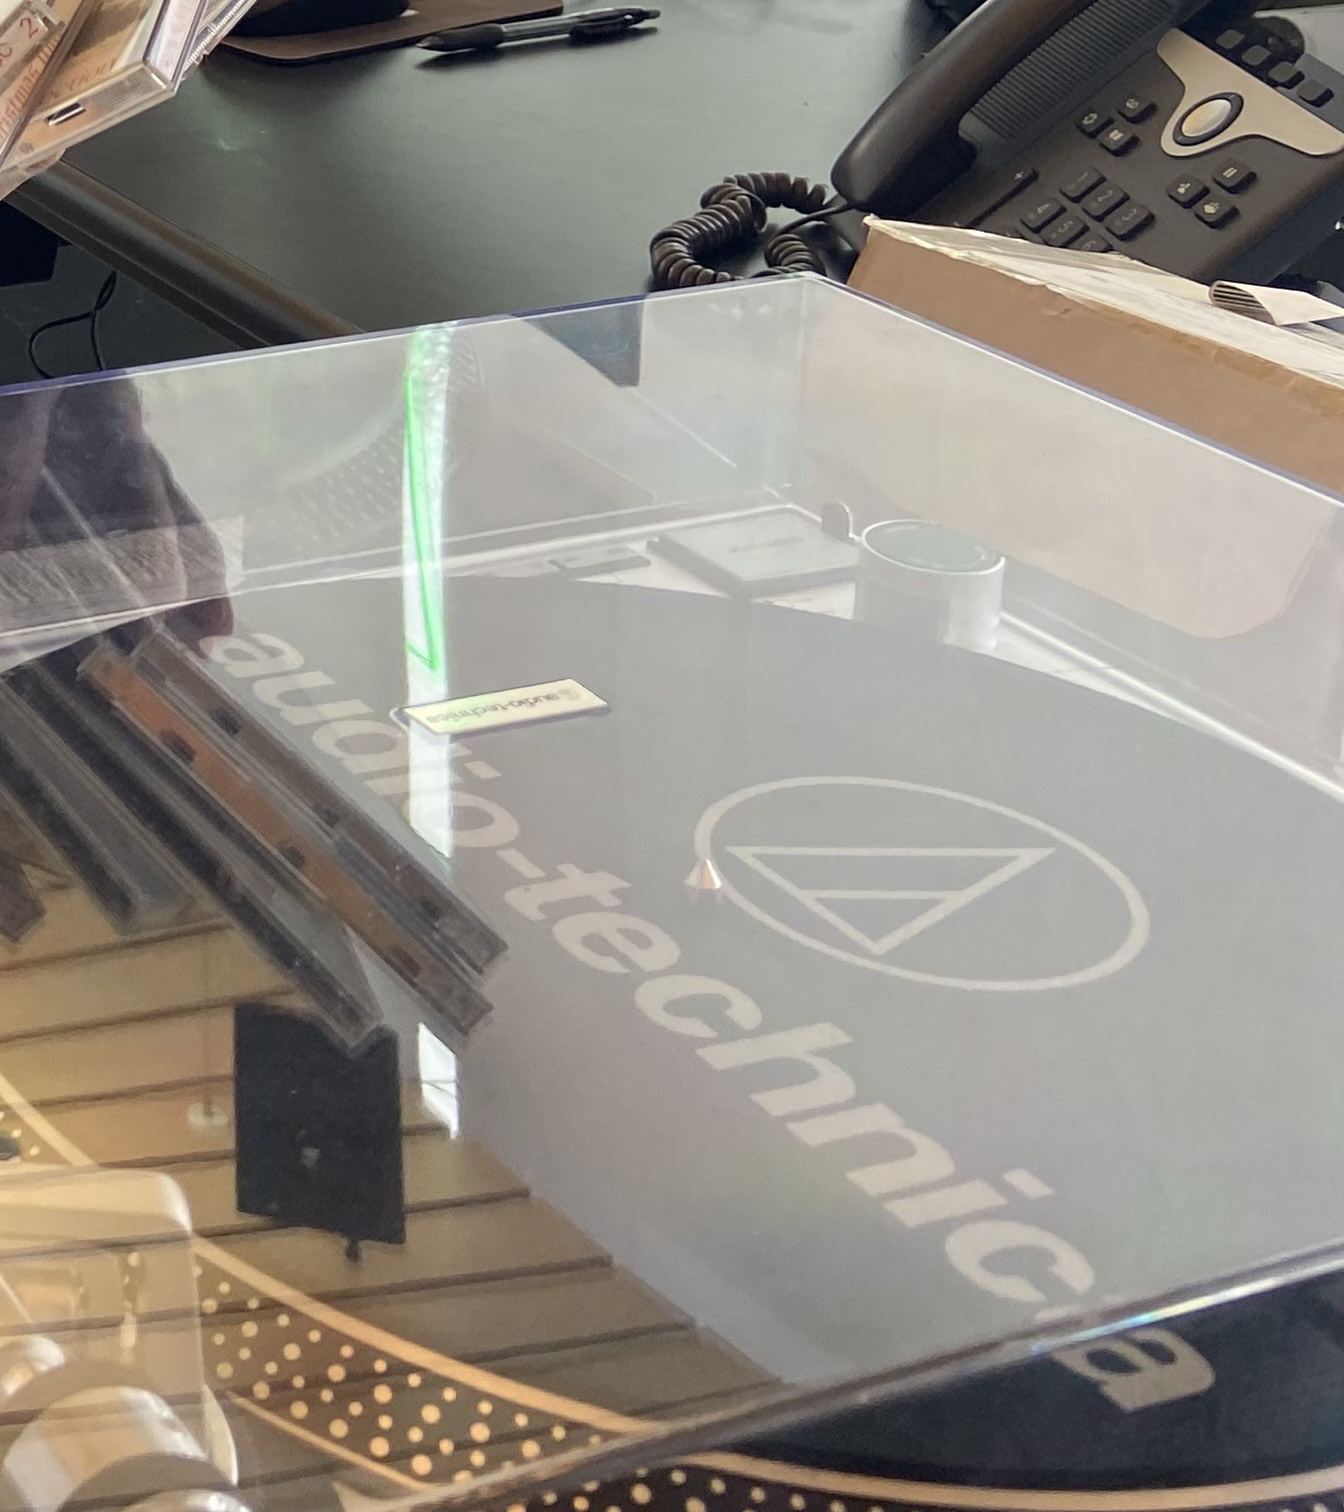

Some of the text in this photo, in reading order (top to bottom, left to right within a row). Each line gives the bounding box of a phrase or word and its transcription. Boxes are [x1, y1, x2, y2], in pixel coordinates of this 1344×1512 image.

[19, 17, 40, 39] 2
[426, 692, 561, 724] audio-technica
[198, 632, 1217, 1414] audio-technica
